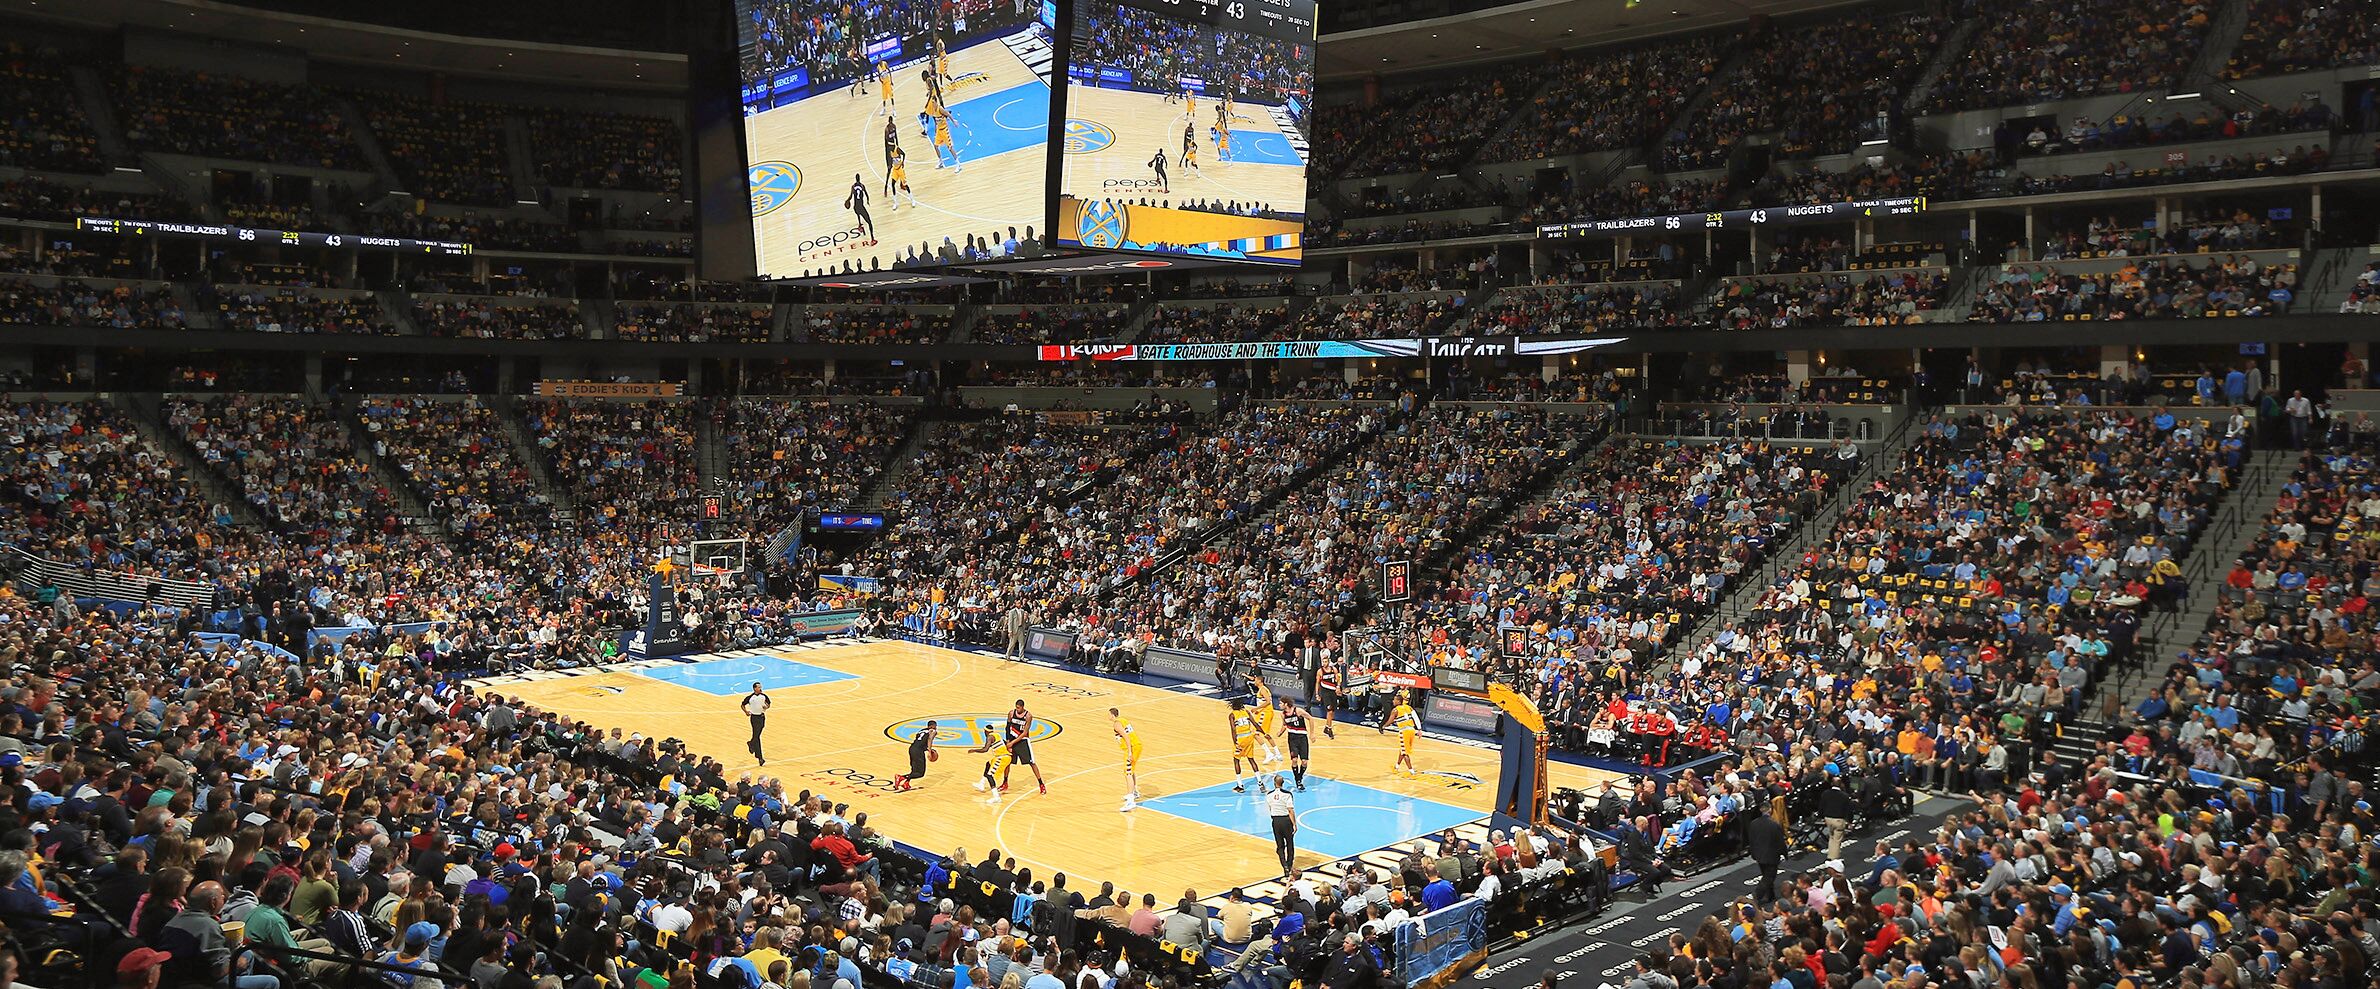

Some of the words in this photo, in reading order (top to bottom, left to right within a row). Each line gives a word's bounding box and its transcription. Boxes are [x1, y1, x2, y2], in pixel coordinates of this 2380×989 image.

[1201, 6, 1207, 15] 2
[1226, 2, 1245, 19] 43
[1260, 10, 1282, 20] TIMEOUTS
[1788, 204, 1834, 216] NUGGETS
[1864, 208, 1871, 216] 4
[1706, 213, 1722, 221] 2:32
[1750, 210, 1766, 223] 43
[1596, 219, 1656, 230] TRAILBLAZERS
[1666, 218, 1680, 229] 56
[114, 226, 119, 234] 1
[158, 224, 228, 236] TRAILBLAZERS
[239, 230, 255, 240] 56
[326, 235, 341, 246] 43
[360, 238, 400, 246] NUGGETS
[799, 240, 869, 262] CENTER
[1142, 345, 1170, 358] GATE
[1173, 344, 1234, 360] ROADHOUSE
[1235, 343, 1258, 358] AND
[1262, 342, 1280, 358] THE
[1284, 342, 1320, 357] TRUNK
[573, 385, 618, 394] EDDIE'S
[622, 386, 648, 394] KIDS
[705, 498, 719, 506] 2:31
[706, 506, 718, 518] 19
[1390, 566, 1405, 577] 2:31
[1392, 576, 1404, 595] 19
[654, 637, 679, 645] CenturyLink
[1510, 632, 1524, 641] 2:31
[1512, 641, 1524, 652] 19
[1150, 656, 1177, 670] COPPER'S
[1177, 660, 1190, 672] NEW
[1190, 663, 1216, 676] ON-MOU
[1697, 880, 1724, 894] TOYOTA
[1671, 902, 1703, 917] TOYOTA
[1598, 915, 1636, 932] TOYOTA
[1645, 927, 1680, 942] TOYOTA
[1570, 942, 1607, 958] TOYOTA
[1491, 957, 1531, 976] TOYOTA
